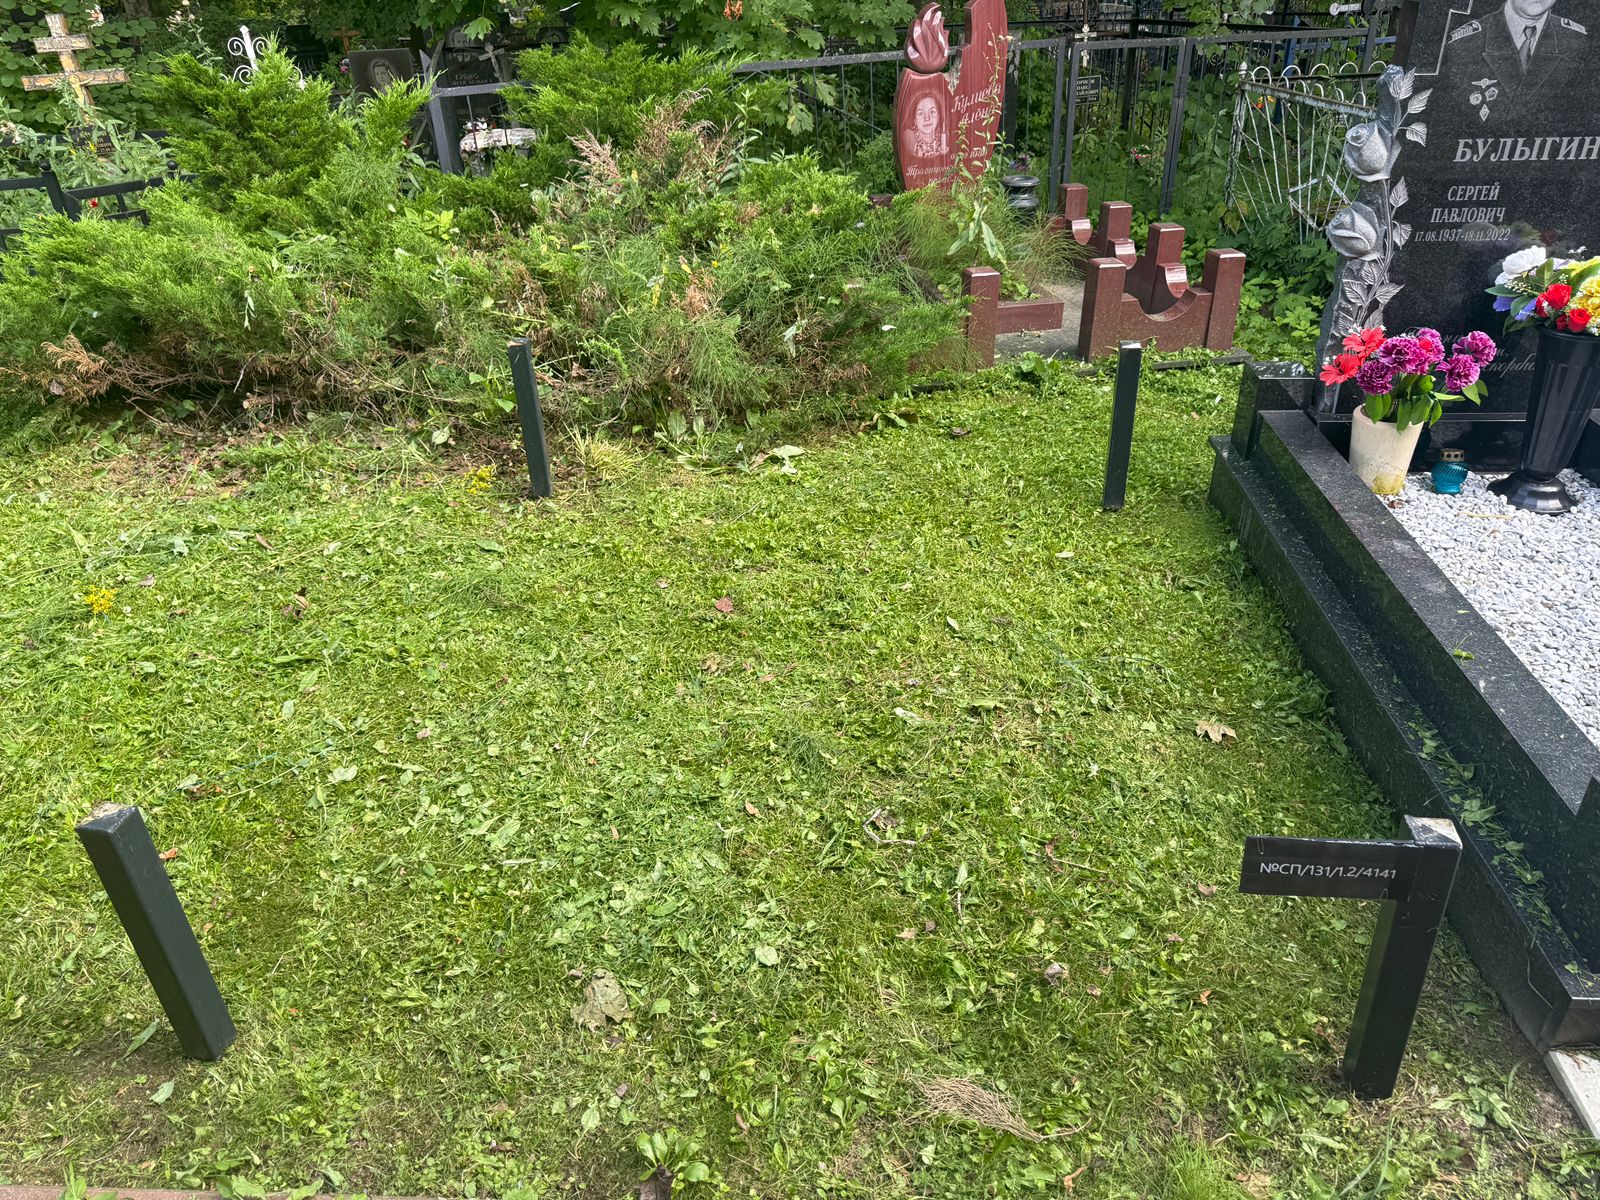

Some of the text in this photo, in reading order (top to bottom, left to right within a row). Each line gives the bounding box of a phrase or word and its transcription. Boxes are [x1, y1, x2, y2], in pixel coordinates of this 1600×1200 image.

[1453, 136, 1600, 162] БУЛЫГИН
[1447, 182, 1501, 201] СЕРГЕЙ
[1430, 207, 1506, 223] ПАВЛОВИЧ
[1415, 228, 1511, 242] 17.08.1937-18.11.2022
[1259, 862, 1397, 879] №СП/131/1.2/4141
